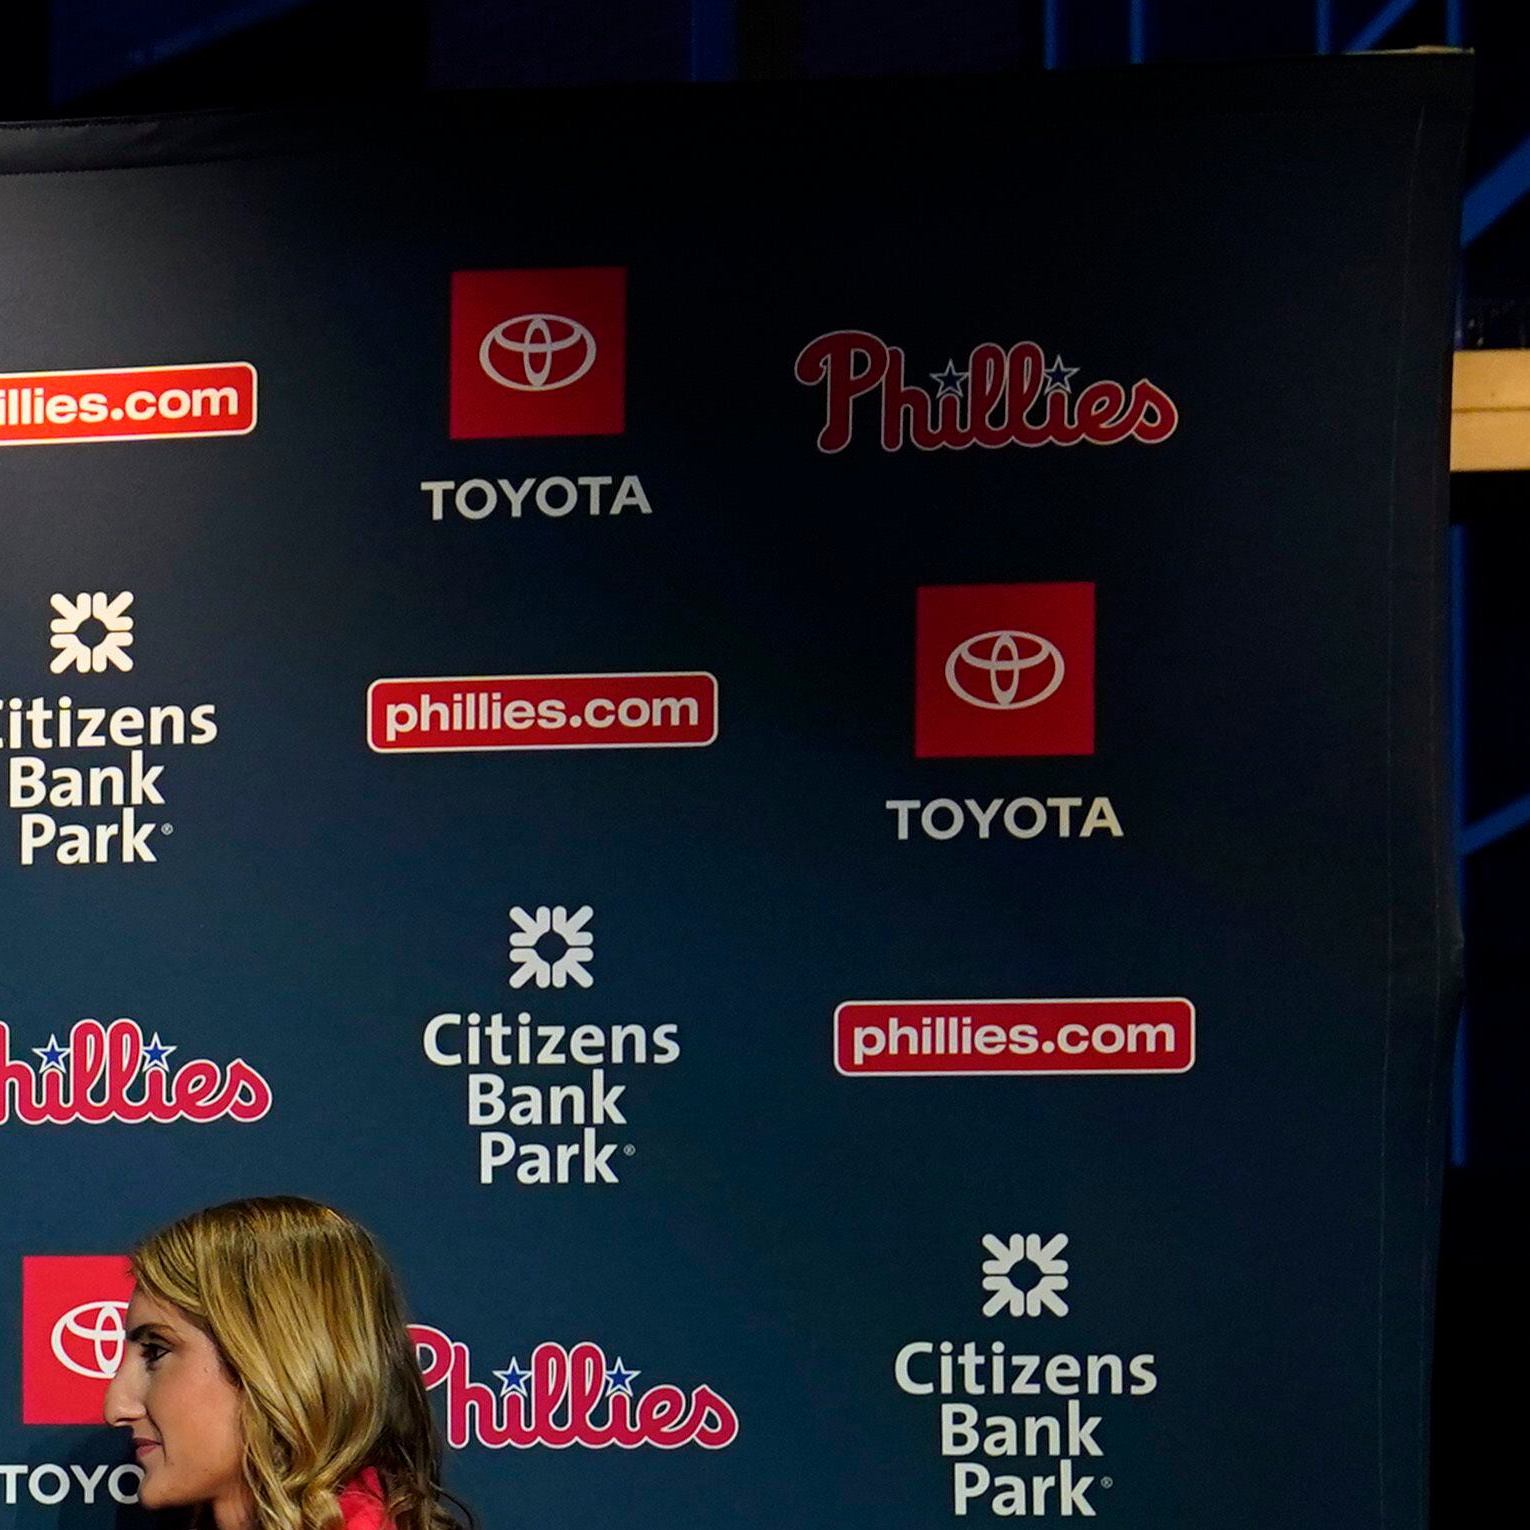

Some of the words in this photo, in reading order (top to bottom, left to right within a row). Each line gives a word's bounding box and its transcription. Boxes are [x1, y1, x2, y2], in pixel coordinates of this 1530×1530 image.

[794, 330, 1179, 454] Phillies
[421, 476, 652, 520] TOYOTA
[386, 692, 698, 741] phillies.com
[9, 750, 165, 809] Bank
[22, 808, 156, 865] Park
[886, 797, 1123, 840] TOYOTA
[424, 1012, 680, 1065] Citizens
[854, 1017, 1175, 1065] phillies.com
[469, 1069, 626, 1125] Bank
[481, 1127, 619, 1184] Park
[895, 1341, 1157, 1395] Citizens
[942, 1399, 1103, 1456] Bank
[955, 1459, 1096, 1516] Park
